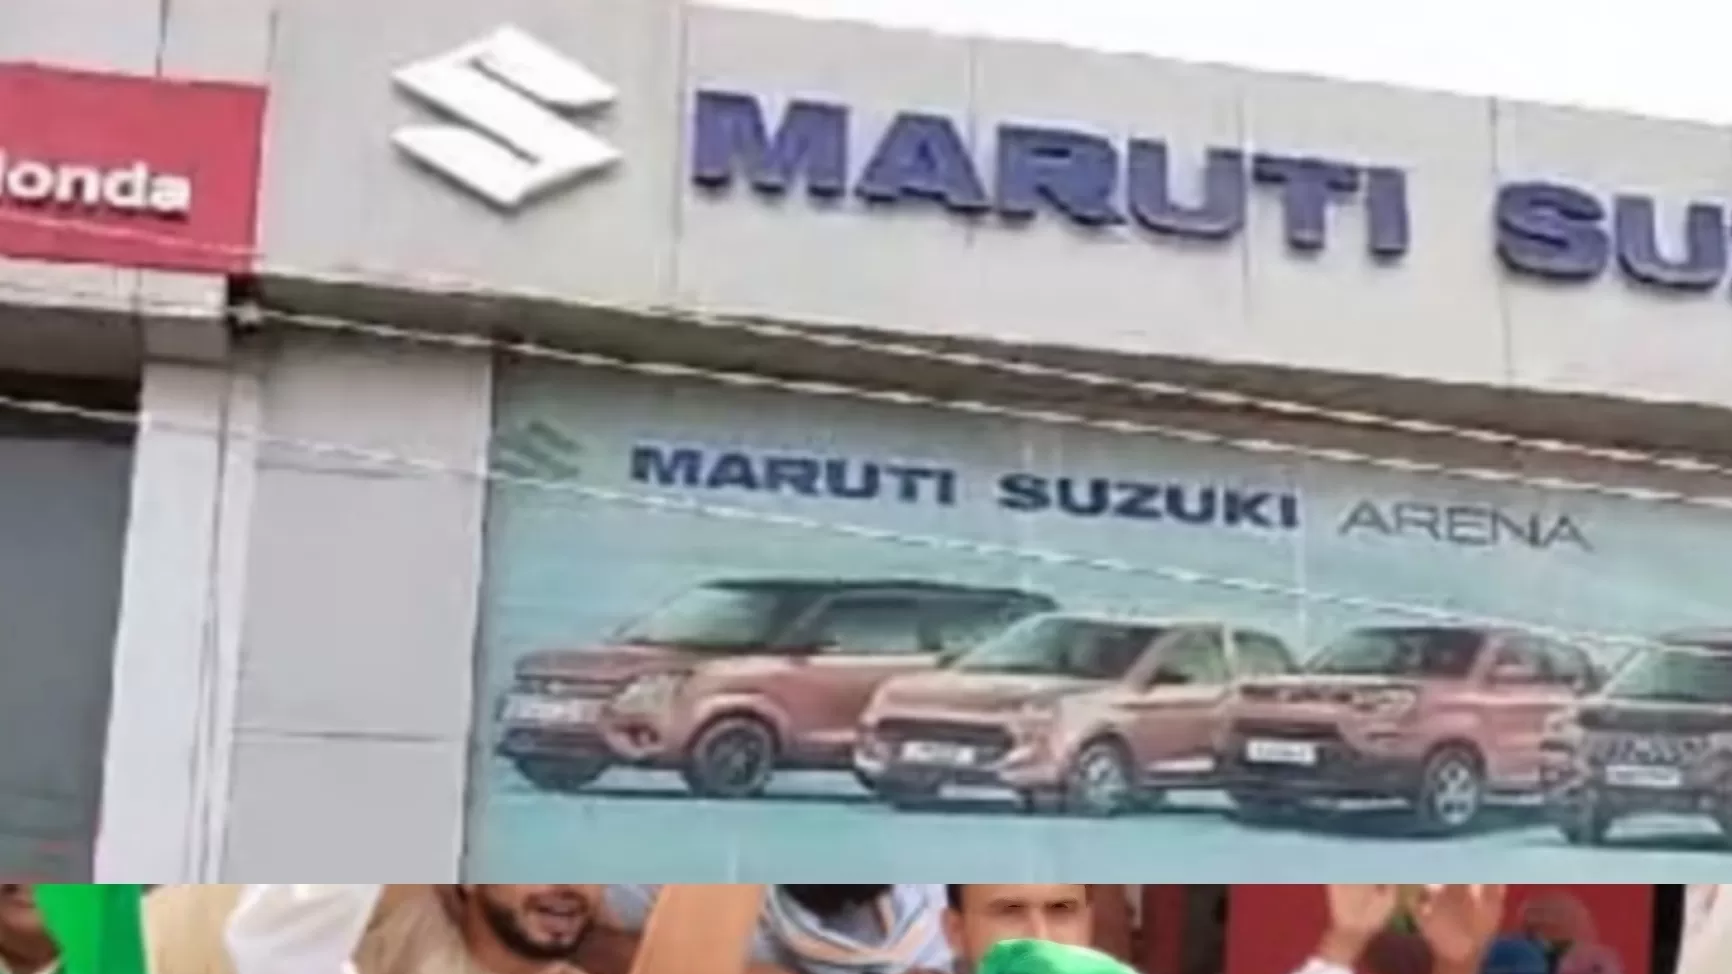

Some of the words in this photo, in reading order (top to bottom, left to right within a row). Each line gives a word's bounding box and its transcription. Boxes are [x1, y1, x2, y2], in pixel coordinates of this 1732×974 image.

[0, 146, 192, 212] onda
[692, 88, 1411, 258] MARUTI
[629, 445, 957, 507] MARUTI
[999, 471, 1299, 530] SUZUKI
[1337, 497, 1595, 553] ARENA
